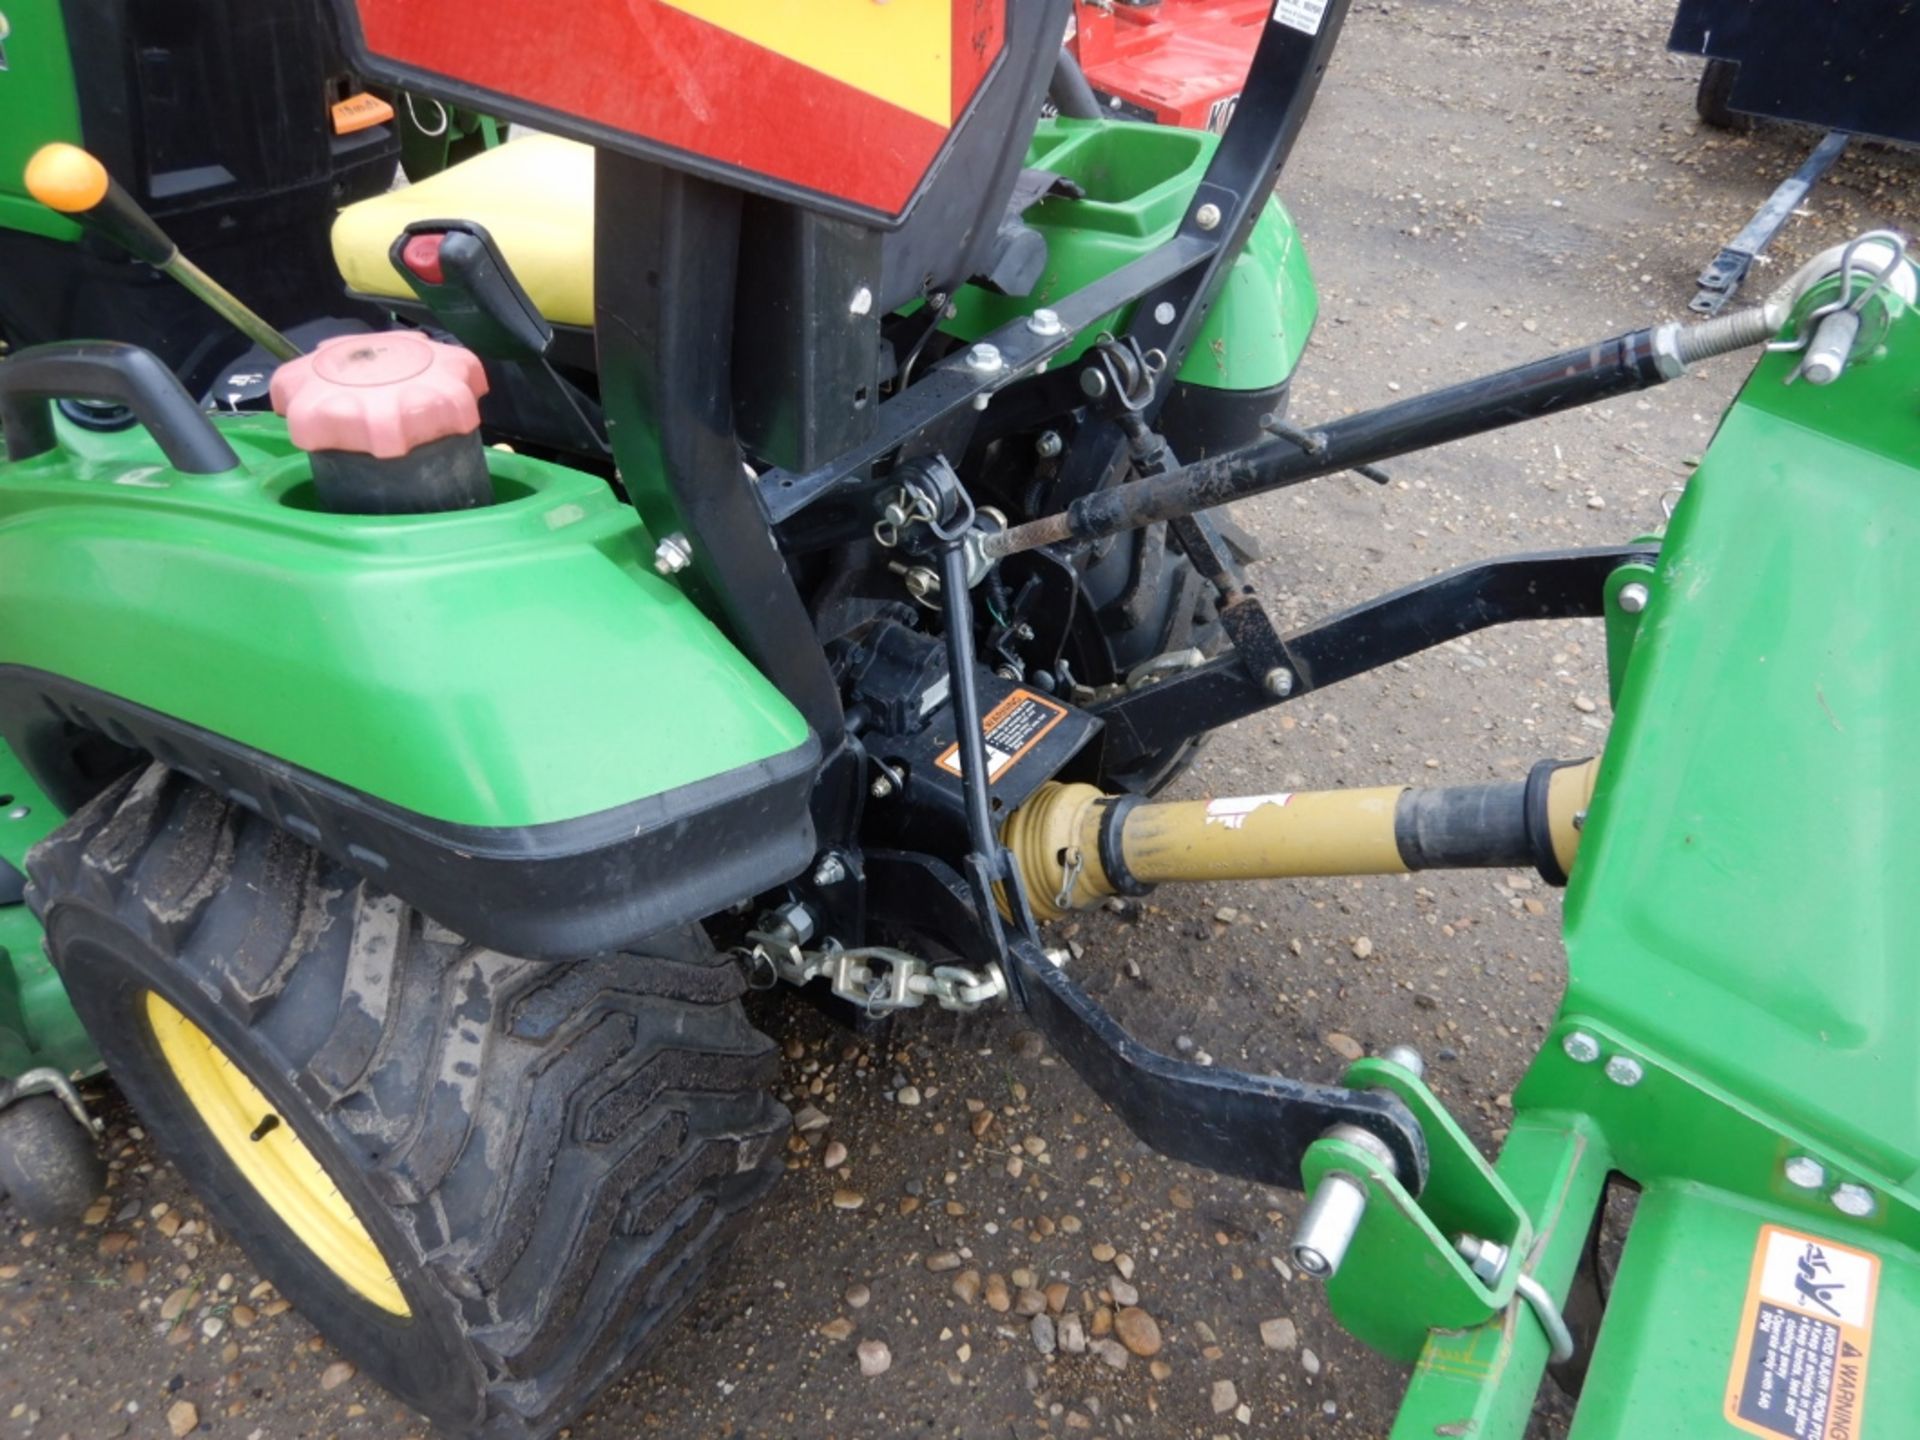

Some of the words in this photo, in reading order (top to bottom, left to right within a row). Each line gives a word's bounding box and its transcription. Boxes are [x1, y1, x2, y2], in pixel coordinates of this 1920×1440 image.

[1760, 1311, 1772, 1331] RPM
[1795, 1322, 1809, 1346] Keep
[1808, 1325, 1823, 1350] Keep
[1823, 1325, 1838, 1356] AVOID
[1818, 1355, 1832, 1391] INJURY
[1813, 1391, 1827, 1422] FROM
[1830, 1364, 1857, 1440] WARNING
